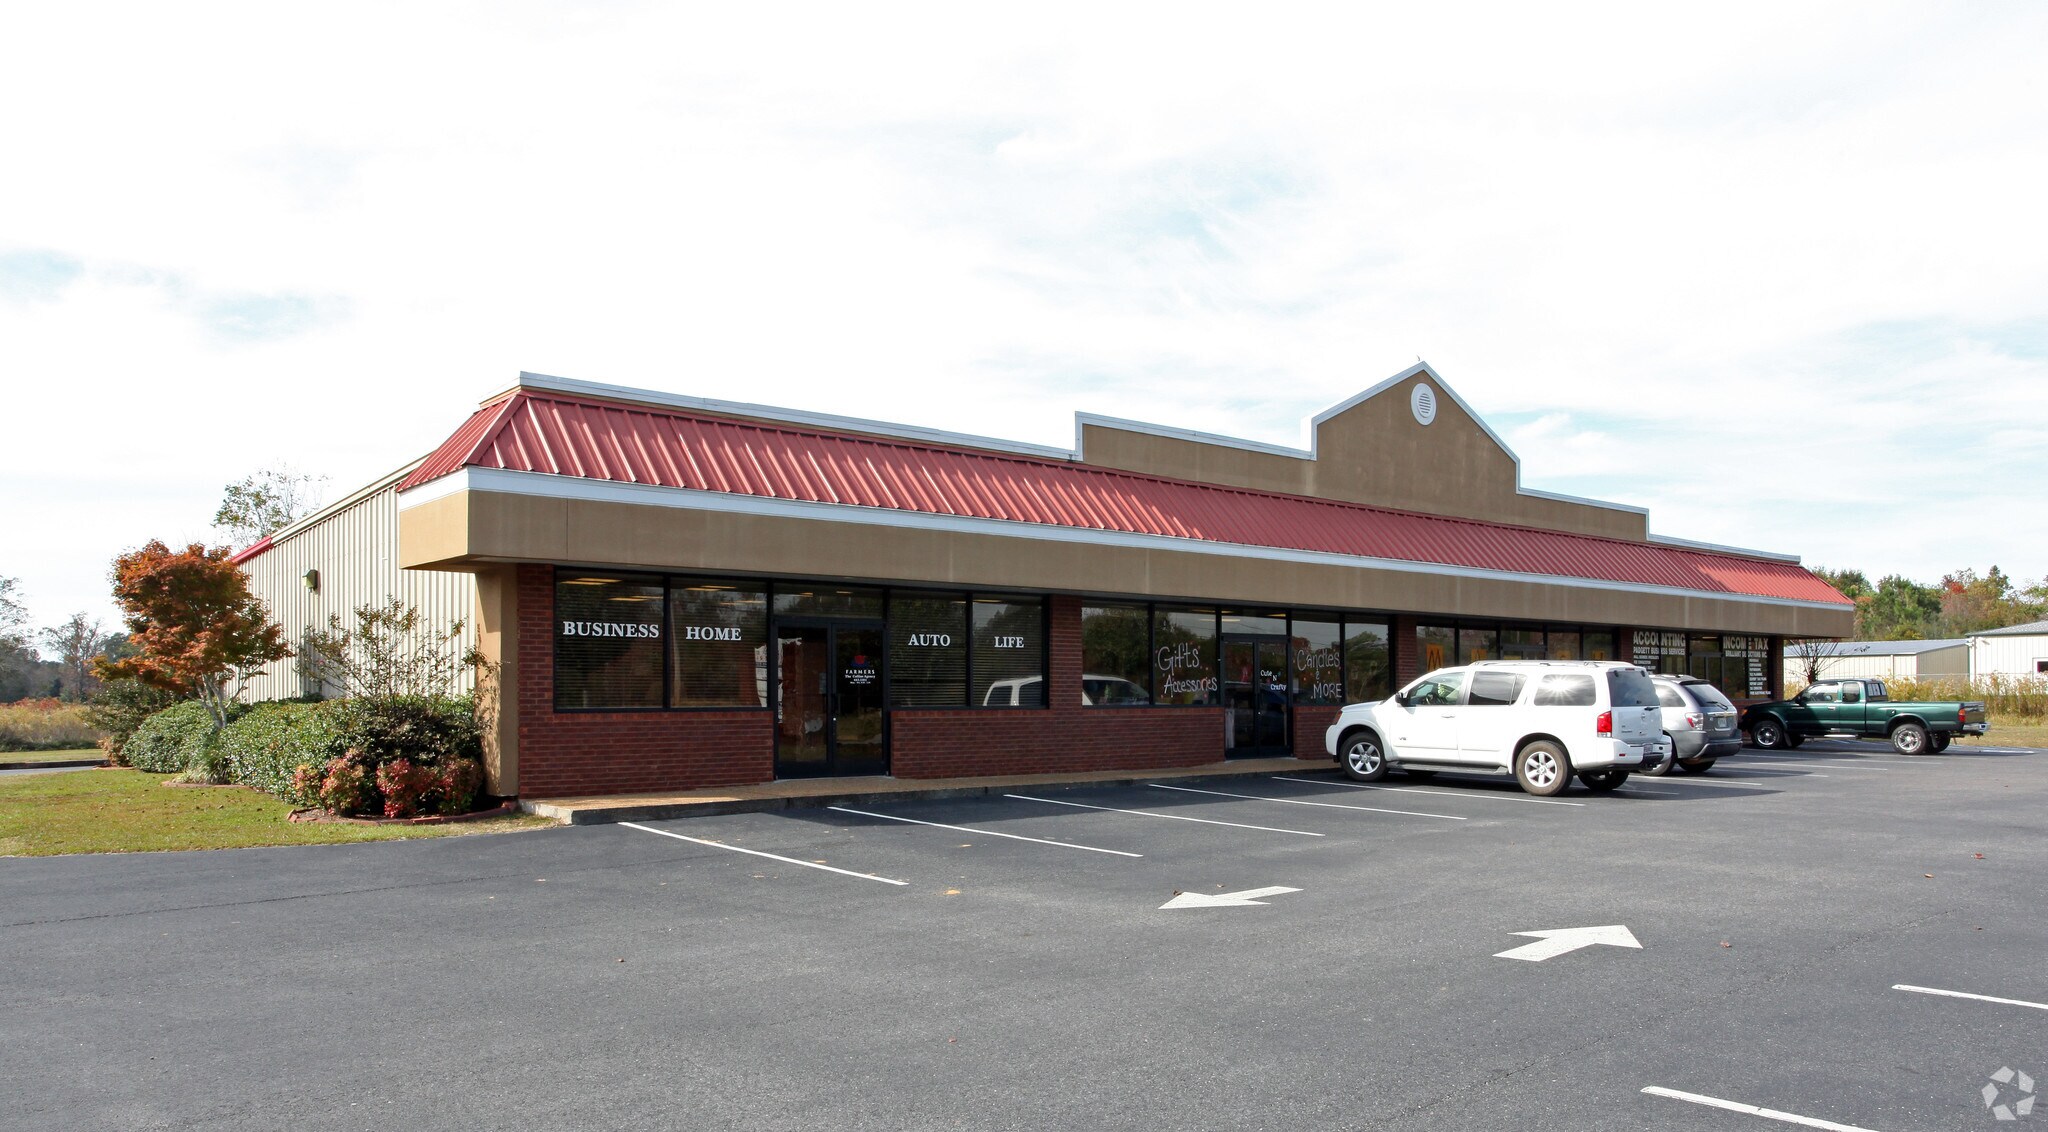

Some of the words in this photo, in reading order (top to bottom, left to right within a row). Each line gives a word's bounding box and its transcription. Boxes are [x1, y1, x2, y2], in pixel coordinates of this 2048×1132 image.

[563, 621, 659, 638] BUSINESS
[686, 626, 742, 641] HOME
[908, 633, 951, 647] AUTO
[994, 636, 1025, 648] LIFE
[1723, 636, 1752, 650] INCOME
[1754, 638, 1769, 650] TAX
[1158, 642, 1200, 676] Gifts
[1651, 647, 1668, 655] BUSIESS
[1297, 649, 1340, 671] Candles
[1164, 674, 1218, 698] Accessories
[1313, 682, 1342, 699] MORE
